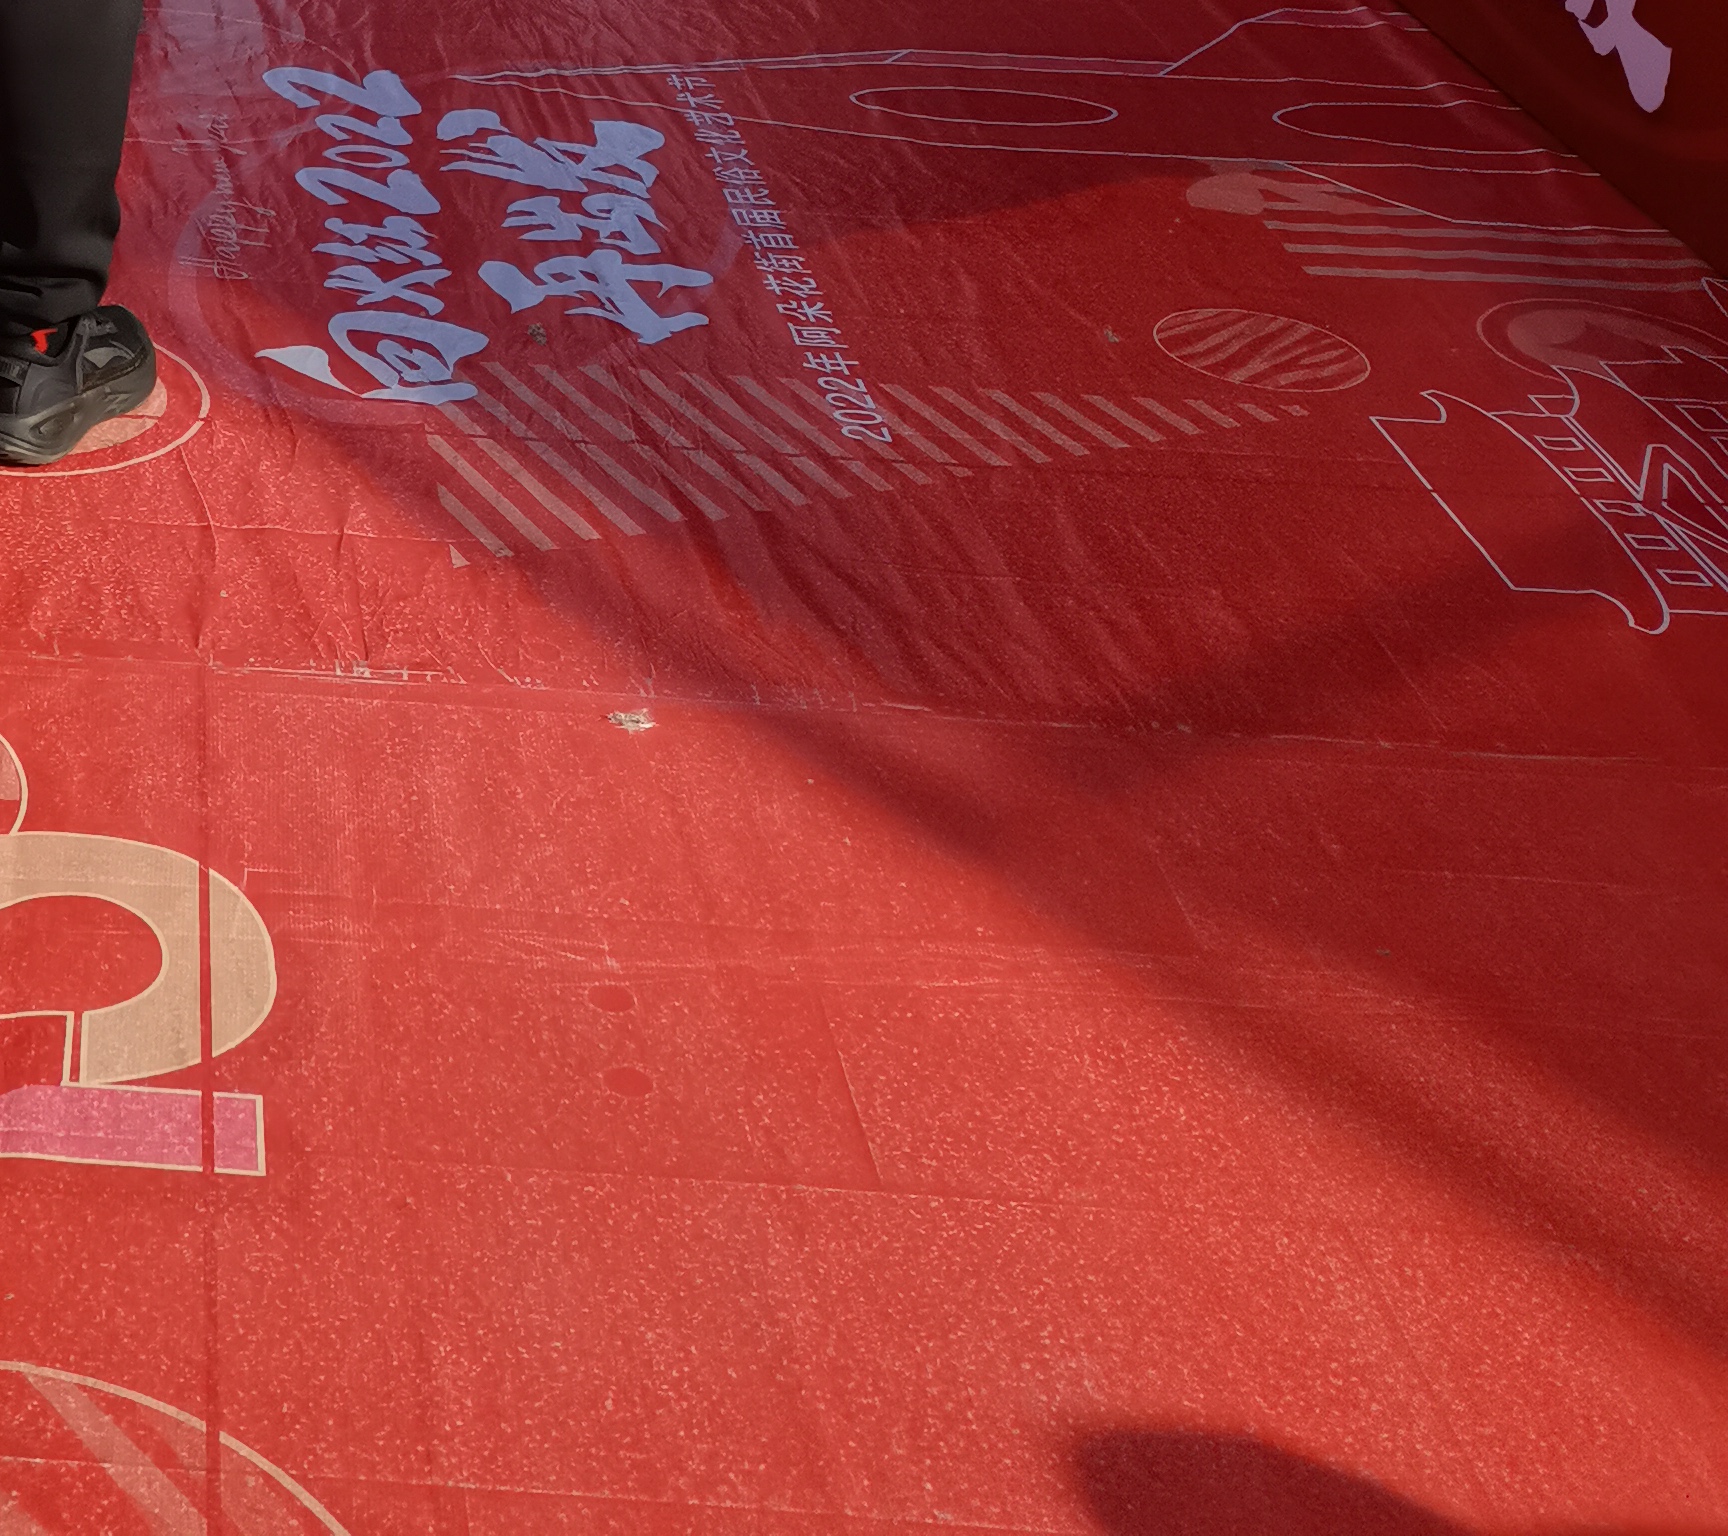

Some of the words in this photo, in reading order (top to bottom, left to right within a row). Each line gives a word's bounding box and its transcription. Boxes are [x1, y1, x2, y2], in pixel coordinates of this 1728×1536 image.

[255, 66, 490, 406] 向火红2022
[436, 108, 713, 346] 再出发
[667, 72, 893, 444] 2022年阿朵花街首届民俗文化艺术节
